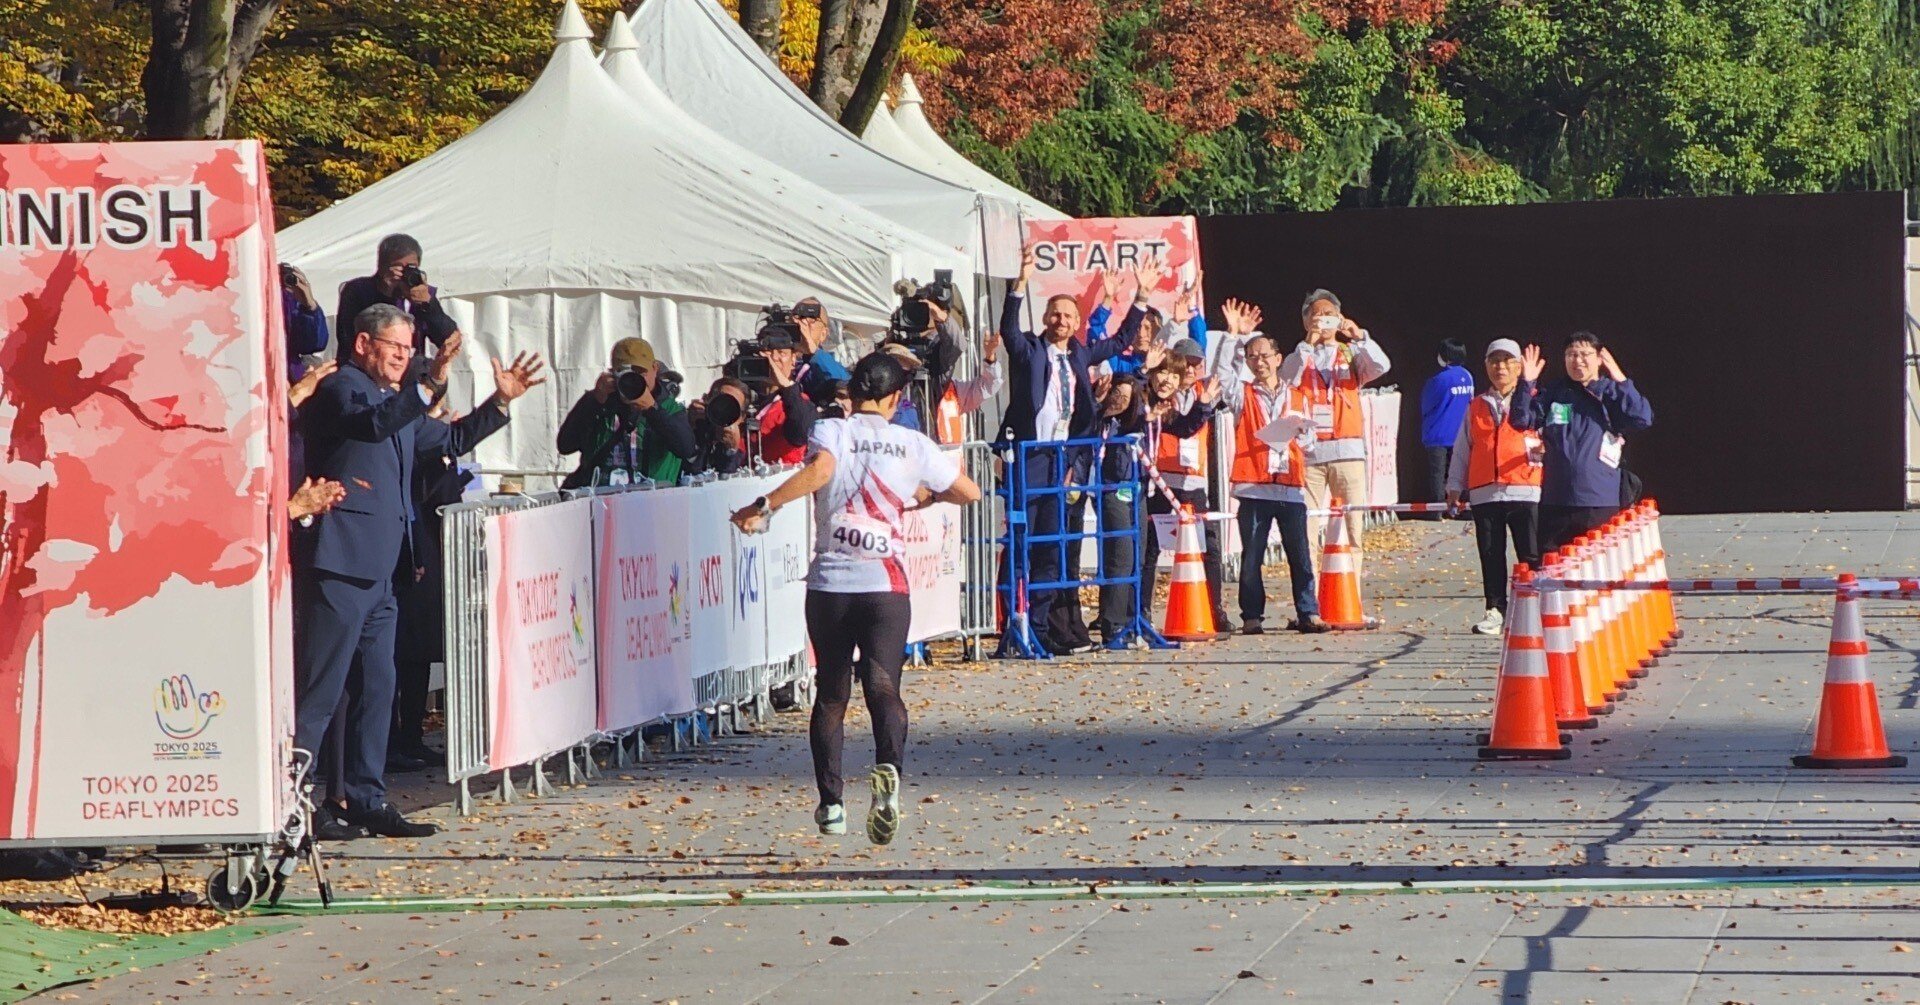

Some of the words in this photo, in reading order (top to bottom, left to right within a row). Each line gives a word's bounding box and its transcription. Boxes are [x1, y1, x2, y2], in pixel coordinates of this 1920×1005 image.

[0, 188, 204, 246] NISH
[1034, 241, 1166, 272] START
[849, 439, 907, 459] JAPAN
[833, 526, 889, 554] 4003
[154, 743, 190, 752] TOKYO
[193, 742, 218, 751] 2025
[82, 775, 158, 795] TOKYO
[166, 774, 219, 793] 2025
[82, 798, 240, 820] DEAFLYMPICS
